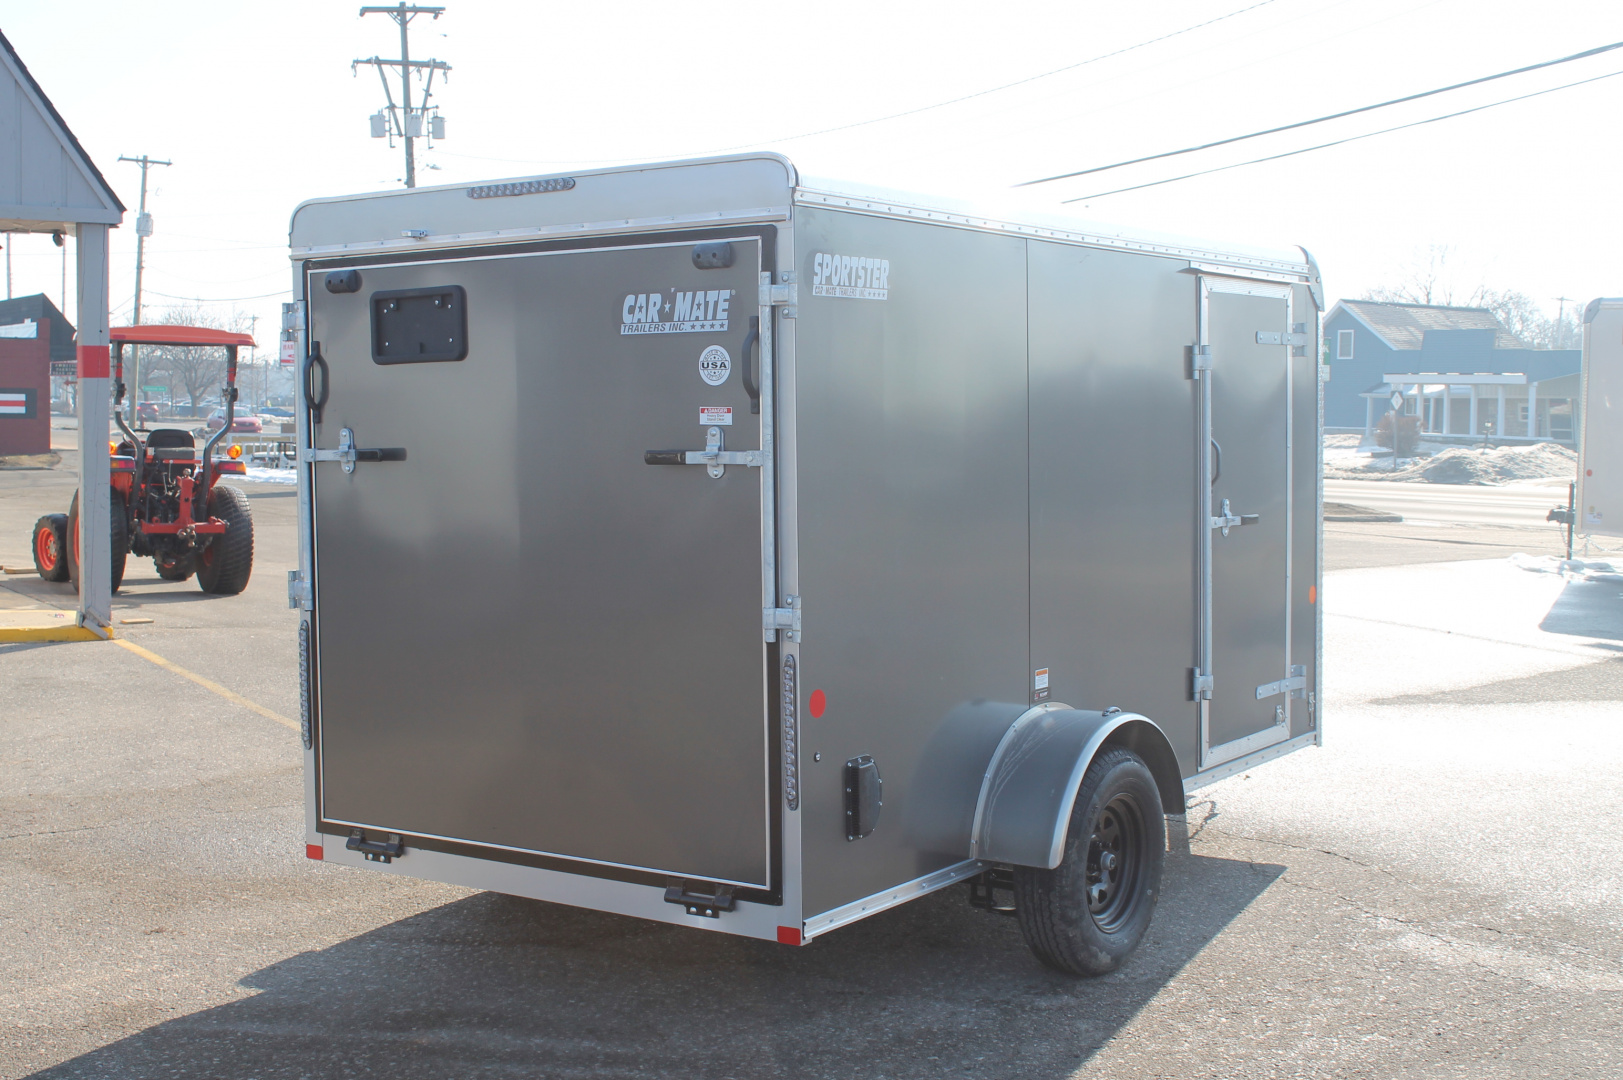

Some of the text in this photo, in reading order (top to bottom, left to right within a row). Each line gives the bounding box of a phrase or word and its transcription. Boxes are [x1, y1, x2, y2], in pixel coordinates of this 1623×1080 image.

[813, 252, 890, 289] SPORTSTER
[622, 322, 688, 334] TRAILERS INC.
[701, 361, 727, 369] USA
